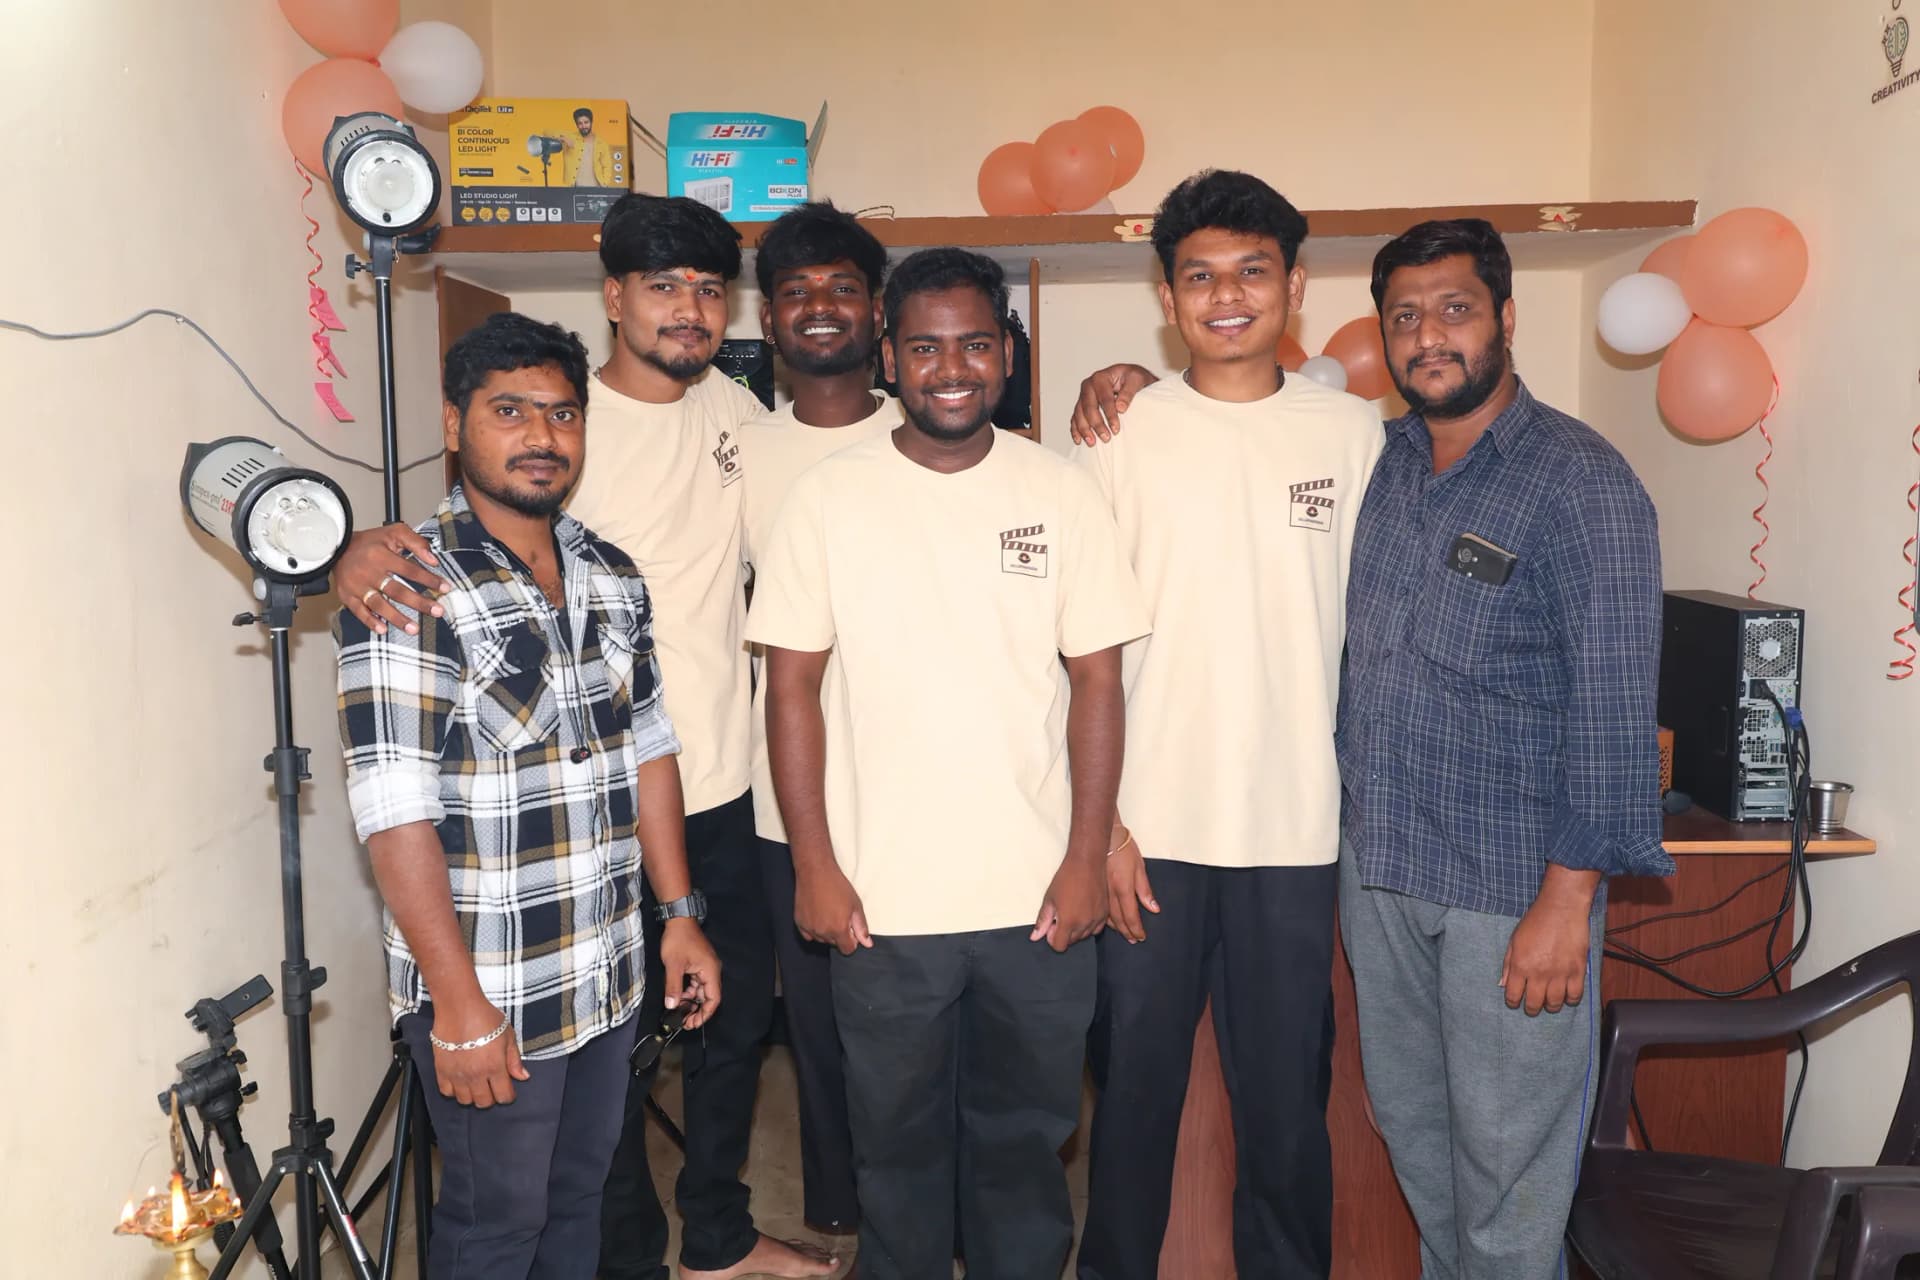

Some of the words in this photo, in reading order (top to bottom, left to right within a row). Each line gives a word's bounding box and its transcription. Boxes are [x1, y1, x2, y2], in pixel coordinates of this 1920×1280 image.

[1871, 69, 1920, 104] CREATIVITY
[712, 125, 767, 138] Hi-Fi
[691, 152, 731, 166] Hi-Fi
